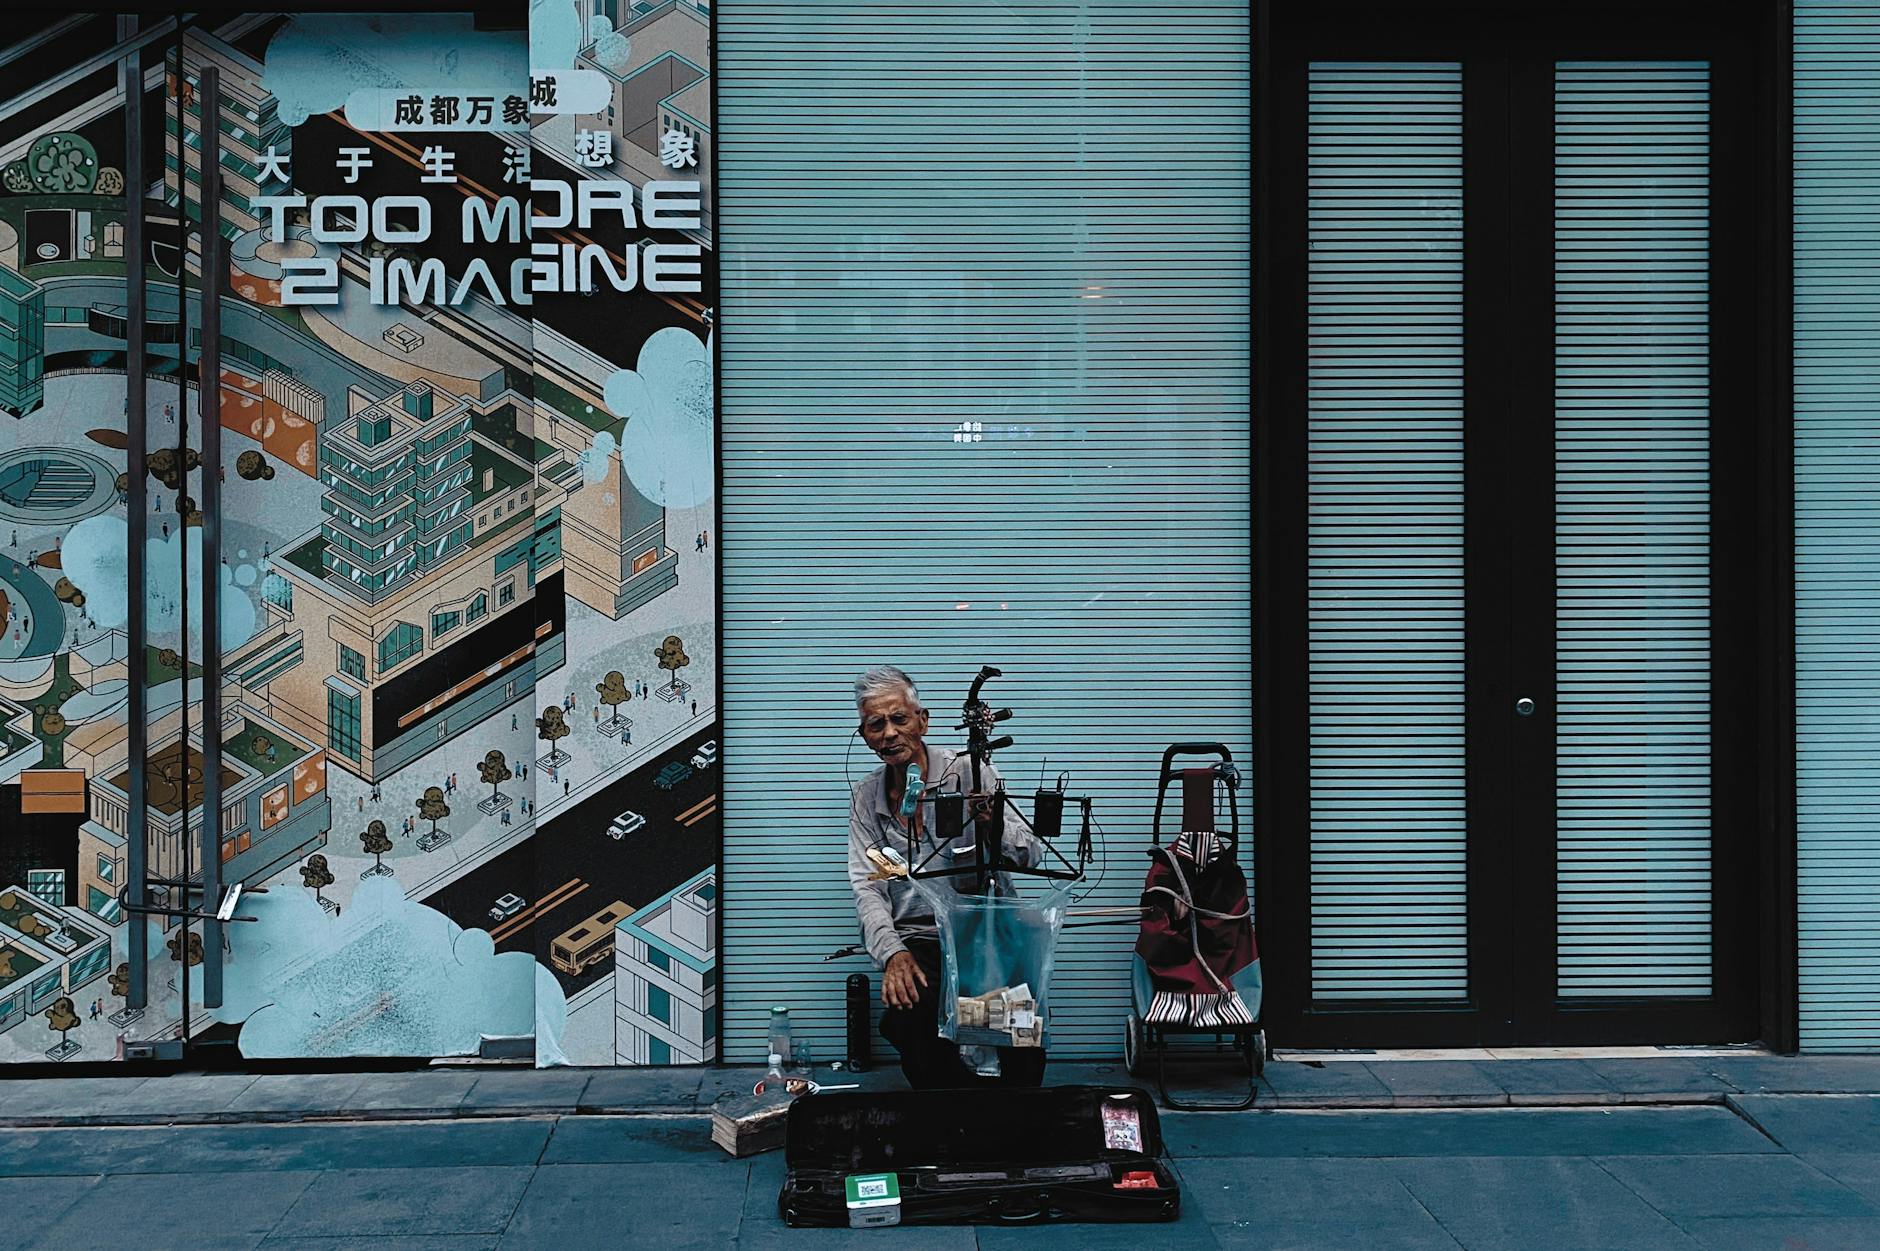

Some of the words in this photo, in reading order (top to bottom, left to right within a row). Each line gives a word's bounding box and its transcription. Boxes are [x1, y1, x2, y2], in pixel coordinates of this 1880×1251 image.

[394, 76, 557, 125] 成都万象城
[249, 195, 432, 243] TOO
[462, 180, 701, 243] MORE
[280, 257, 339, 305] 2
[369, 243, 702, 305] IMAGINE
